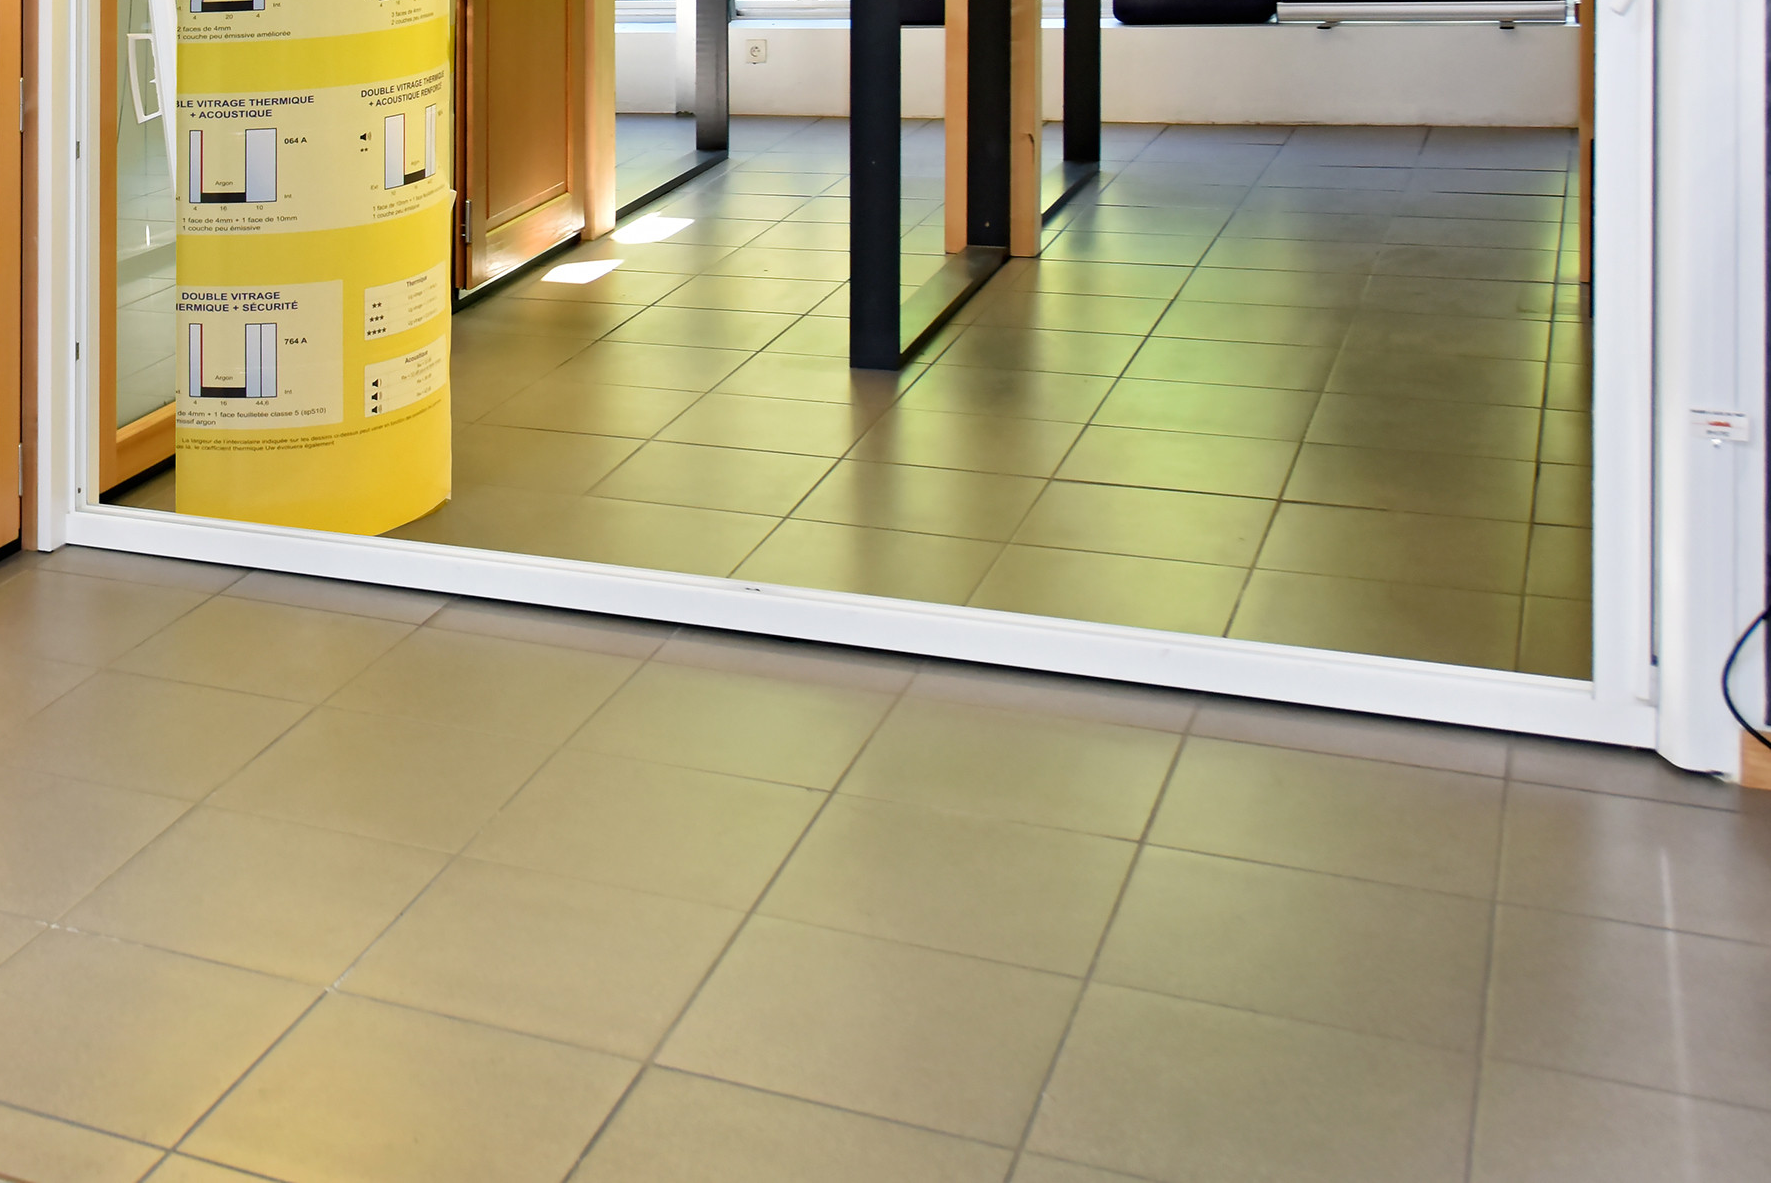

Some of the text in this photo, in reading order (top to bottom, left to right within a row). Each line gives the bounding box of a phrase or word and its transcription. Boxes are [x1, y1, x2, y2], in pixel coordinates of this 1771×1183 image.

[361, 86, 394, 97] DOUBLE
[396, 79, 422, 91] VITRAGE
[197, 99, 245, 107] VITRAGE
[249, 96, 314, 107] THERMIQUE
[376, 93, 420, 106] ACOUSTIQUE
[199, 110, 272, 118] ACOUSTIQUE
[231, 292, 280, 300] VITRAGE
[243, 301, 298, 311] SÉCURITÉ
